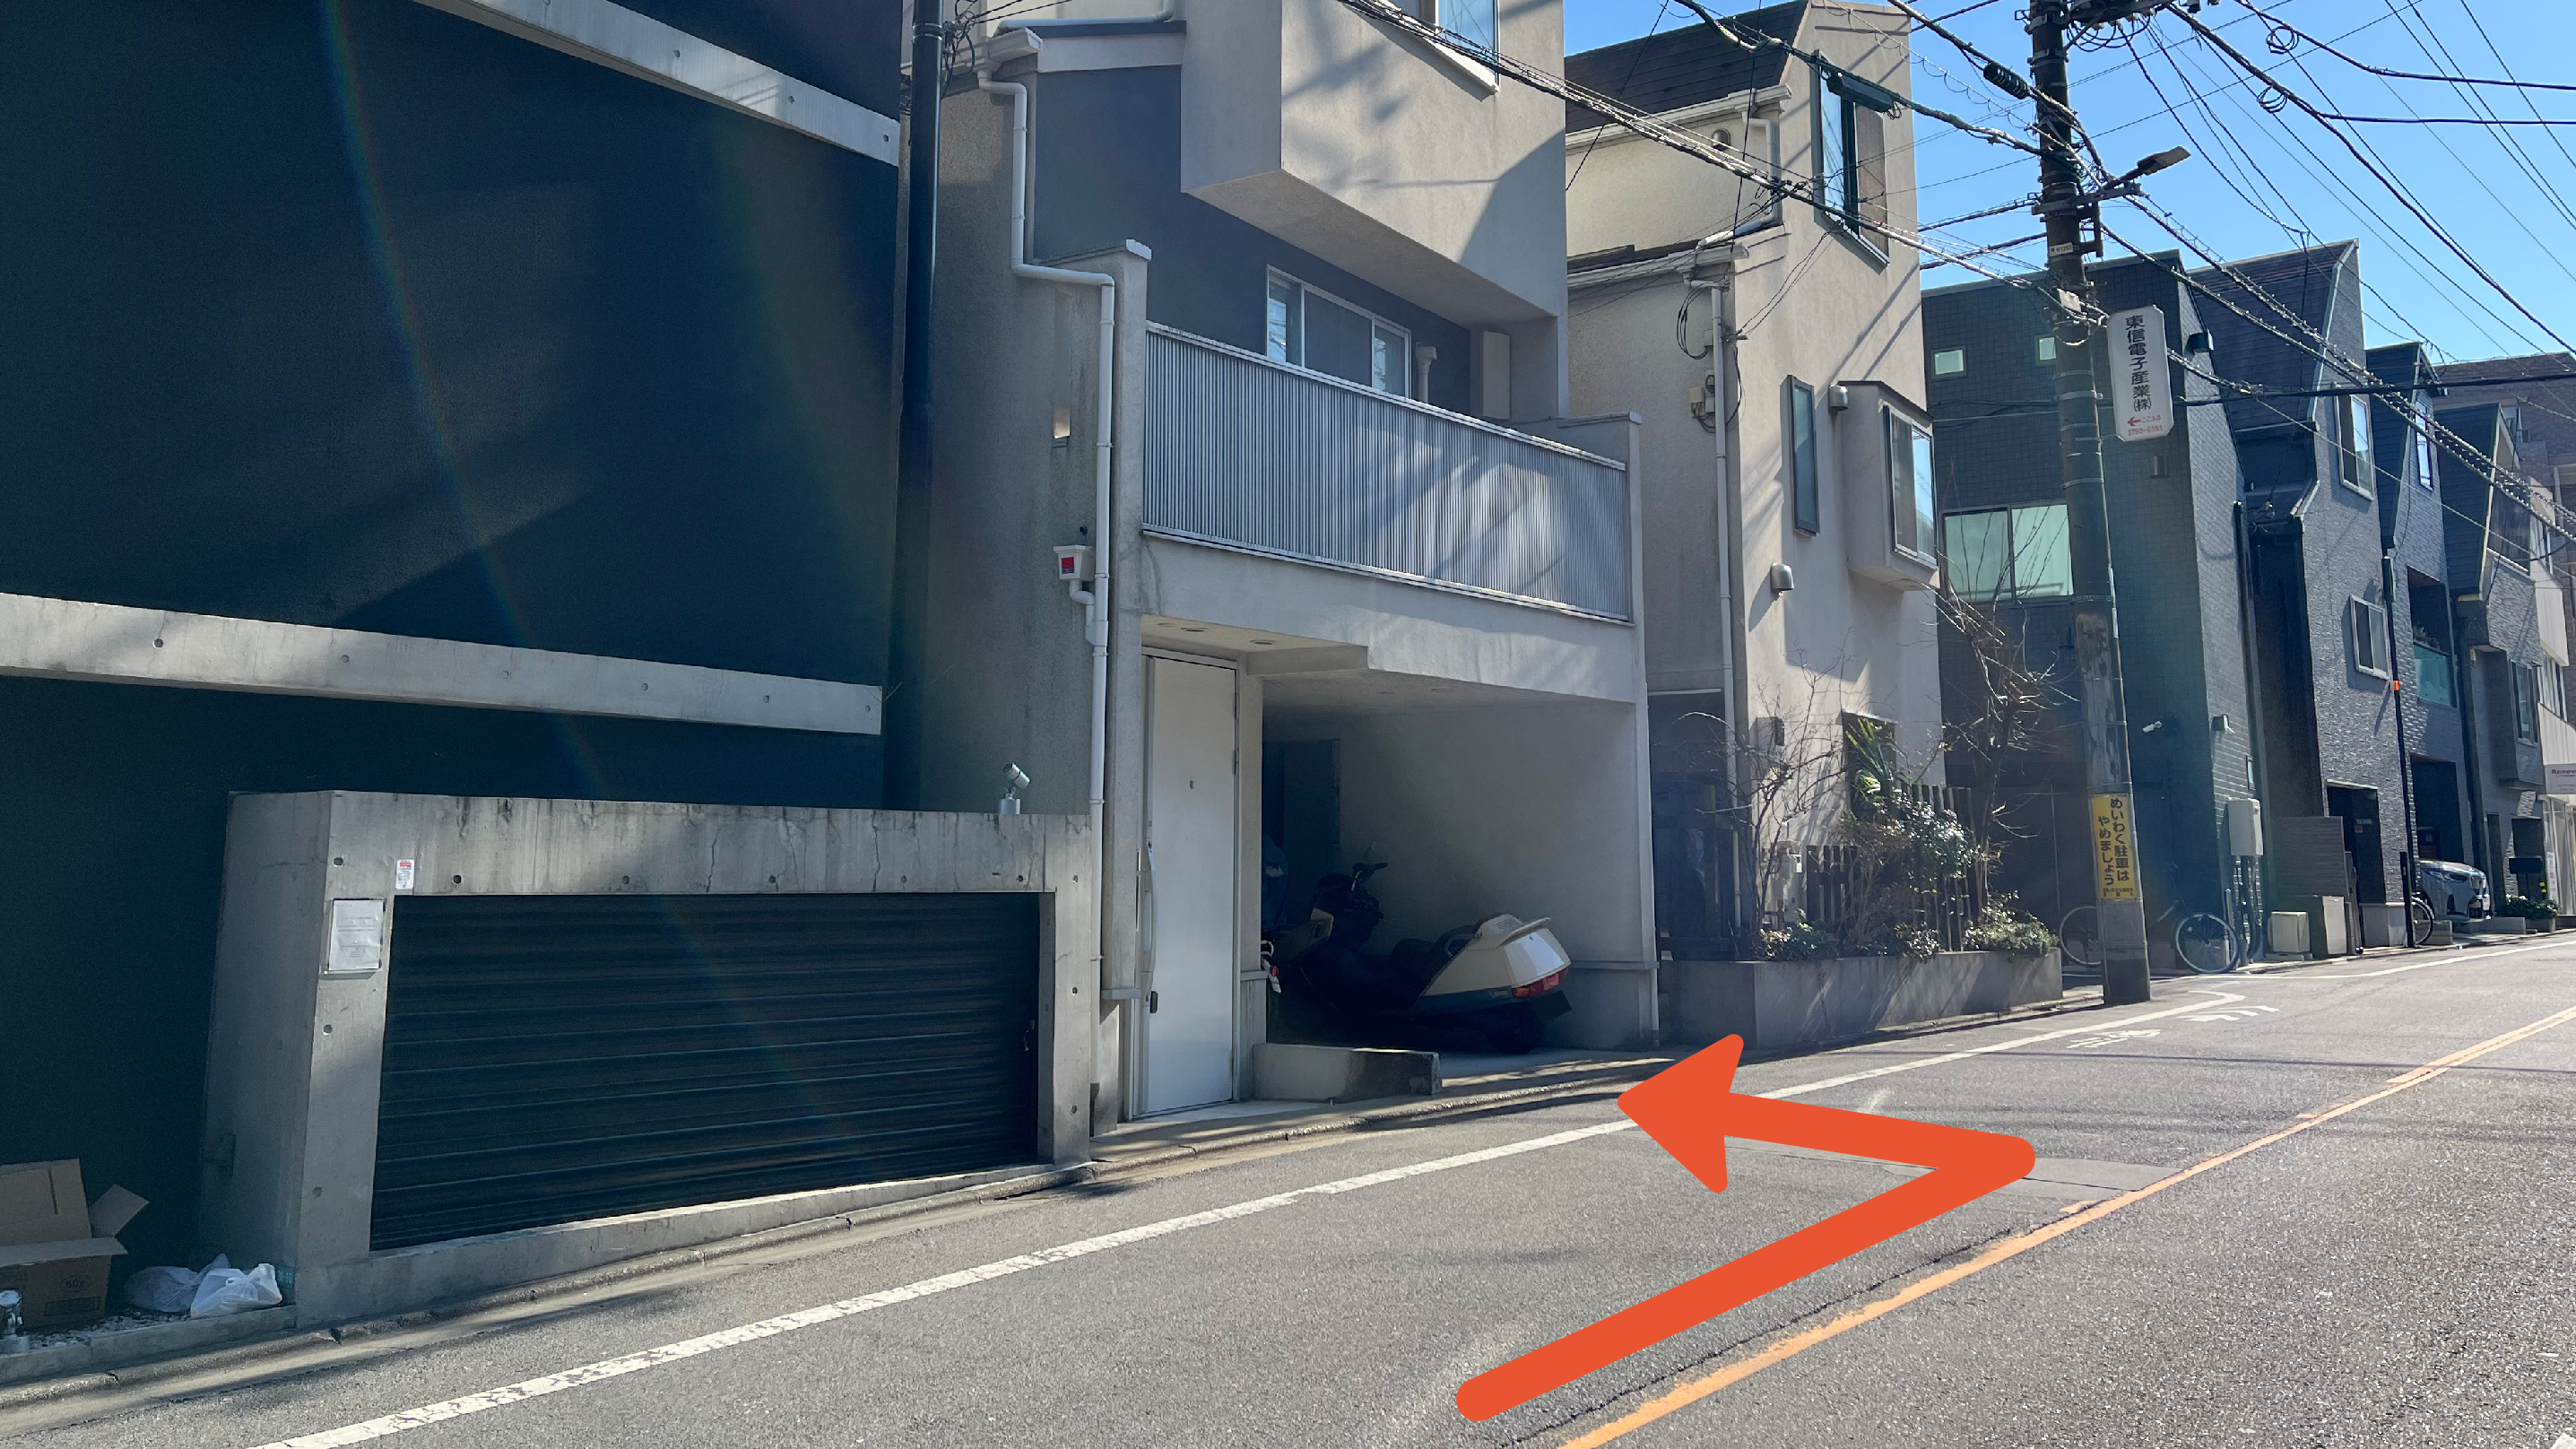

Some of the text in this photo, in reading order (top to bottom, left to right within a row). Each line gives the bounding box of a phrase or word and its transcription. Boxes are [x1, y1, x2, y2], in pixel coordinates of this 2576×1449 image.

[2128, 425, 2163, 436] 3792-6551
[2098, 816, 2114, 885] やめましょう
[2110, 798, 2129, 881] めいわく駐車は
